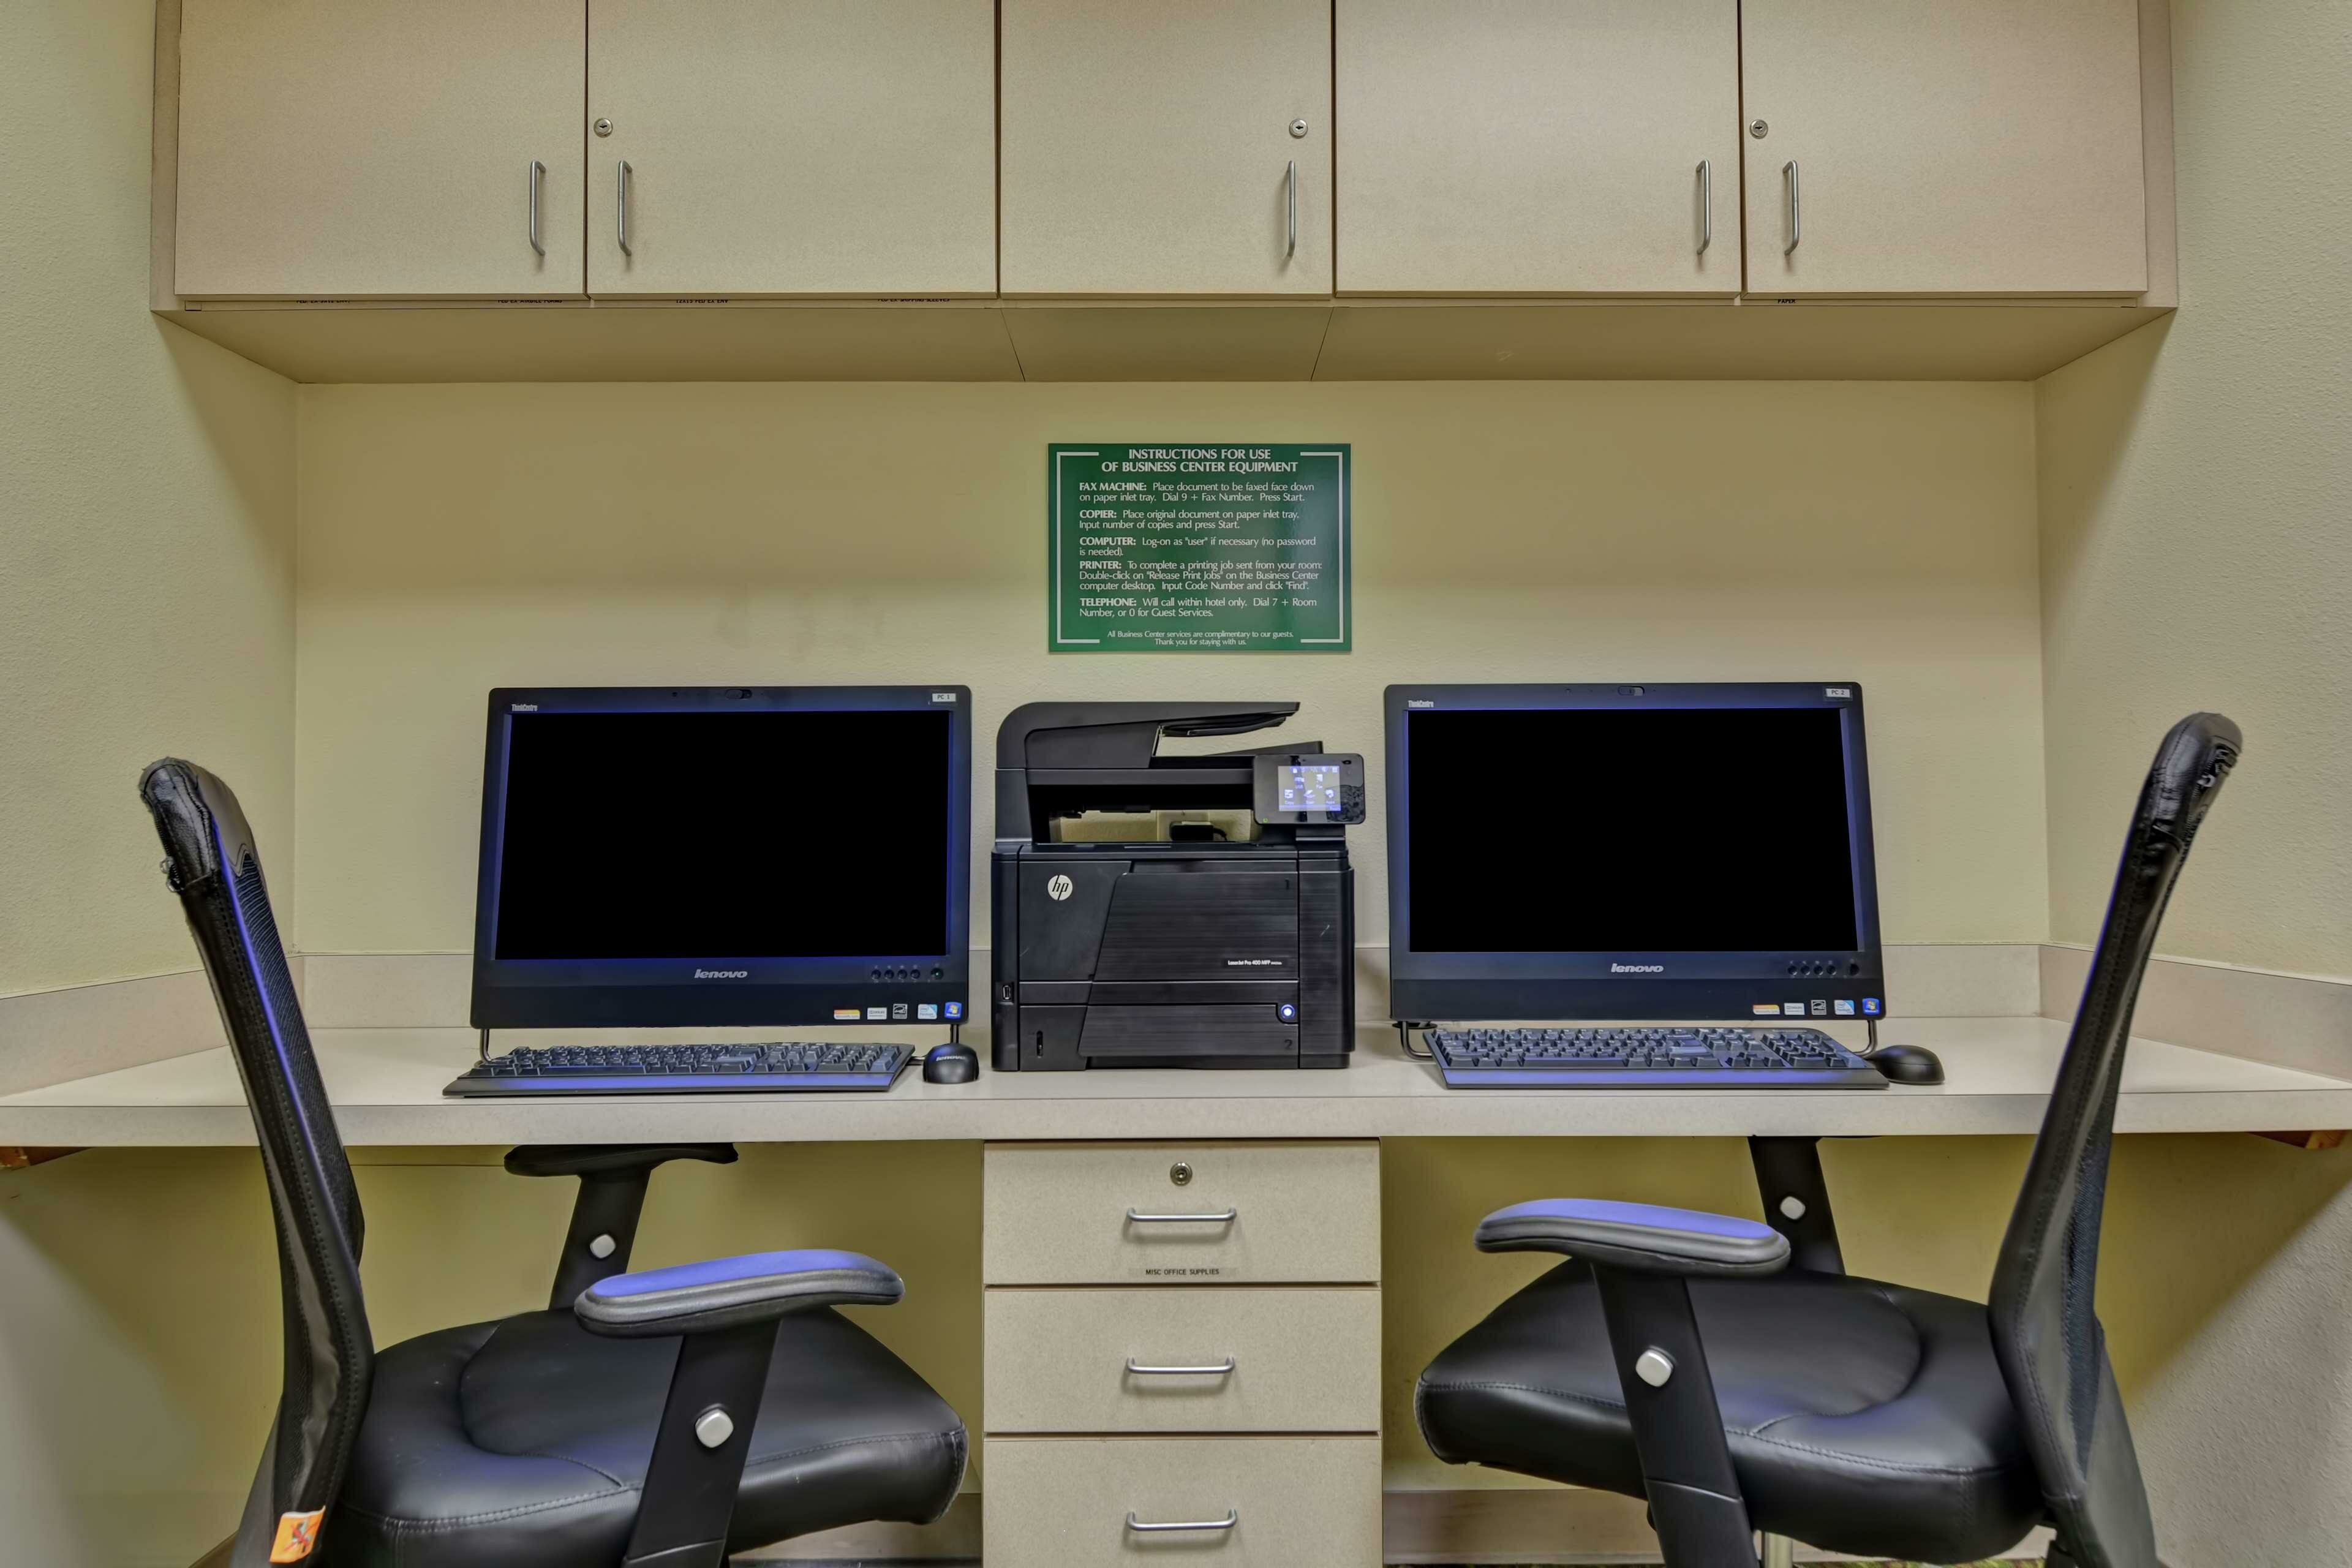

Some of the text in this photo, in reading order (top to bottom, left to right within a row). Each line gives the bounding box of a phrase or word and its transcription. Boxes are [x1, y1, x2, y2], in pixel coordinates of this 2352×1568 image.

[1128, 449, 1272, 459] INSTRUCTIONS FOR USE
[1101, 462, 1299, 474] OF BUSINESS CENTER EQUIPMENT
[1079, 482, 1314, 491] FAX MACHINE: Place document to be faxed face down
[1093, 495, 1118, 504] paper
[1120, 492, 1137, 502] inlet
[1139, 492, 1157, 504] tray.
[1162, 492, 1179, 502] Dial
[1181, 492, 1188, 502] 9
[1201, 492, 1216, 502] Fax
[1218, 492, 1254, 502] Number.
[1259, 492, 1281, 502] Press
[1282, 492, 1305, 502] Start.
[1079, 510, 1118, 519] COPIER:
[1123, 510, 1145, 519] Place
[1146, 510, 1176, 521] original
[1177, 510, 1221, 519] document
[1234, 512, 1261, 521] paper
[1262, 510, 1280, 519] inlet
[1281, 510, 1299, 521] tray.
[1079, 521, 1240, 532] Input number of copies and press Start.
[1079, 537, 1137, 546] COMPUTER:
[1142, 537, 1171, 548] Log-on
[1185, 537, 1208, 546] "user"
[1210, 537, 1216, 546] if
[1218, 540, 1259, 548] necessary
[1261, 537, 1275, 548] (no
[1276, 537, 1316, 548] password
[1079, 546, 1124, 557] is needed).
[1079, 560, 1122, 570] PRINTER:
[1126, 560, 1137, 570] To
[1139, 560, 1178, 572] complete
[1187, 560, 1218, 572] printing
[1220, 560, 1234, 572] job
[1235, 560, 1253, 570] sent
[1255, 560, 1275, 570] from
[1276, 563, 1296, 572] your
[1079, 571, 1131, 579] Double-click
[1146, 571, 1180, 579] "Release
[1182, 571, 1202, 579] Print
[1204, 571, 1224, 579] Jobs"
[1238, 571, 1254, 579] the
[1256, 571, 1290, 579] Business
[1291, 571, 1319, 579] Center
[1079, 581, 1309, 592] computer desktop. Input Code Number and click "Find".
[1079, 598, 1137, 606] TELEPHONE:
[1142, 598, 1159, 606] Will
[1161, 598, 1175, 606] call
[1177, 598, 1203, 606] within
[1205, 598, 1226, 606] hotel
[1227, 598, 1248, 609] only.
[1253, 598, 1270, 606] Dial
[1272, 598, 1278, 606] 7
[1292, 598, 1317, 606] Room
[1079, 608, 1115, 618] Number,
[1128, 608, 1136, 617] 0
[1137, 608, 1150, 617] for
[1151, 608, 1177, 617] Guest
[1178, 608, 1214, 617] Services.
[1204, 631, 1251, 639] complimentary
[1272, 631, 1294, 639] guests.
[1199, 638, 1221, 647] staying
[1051, 875, 1069, 900] hp
[694, 968, 748, 978] lenovo
[1610, 963, 1664, 973] lenovo
